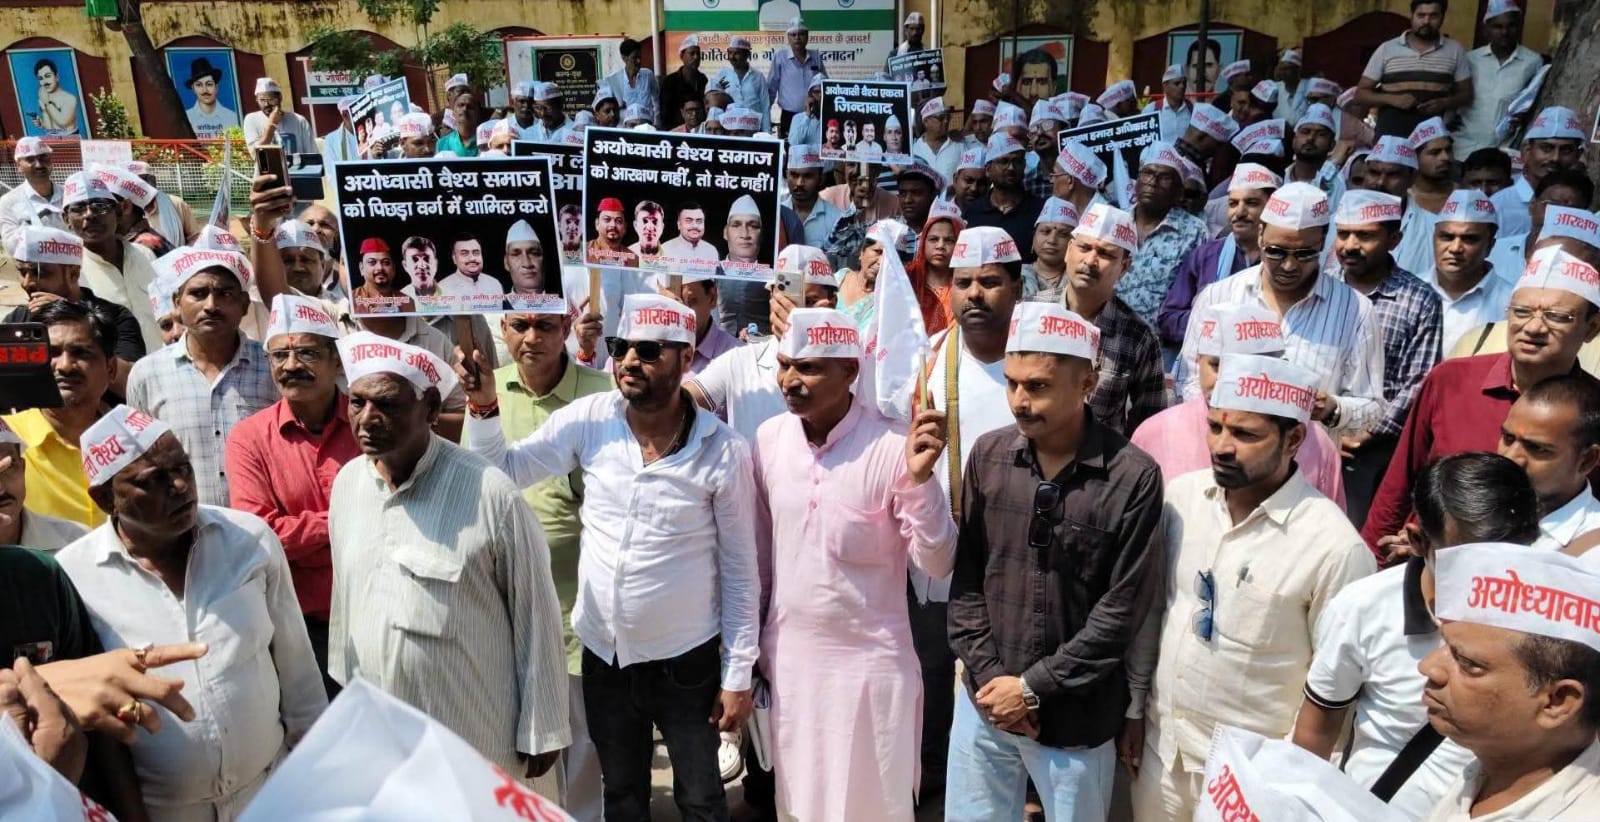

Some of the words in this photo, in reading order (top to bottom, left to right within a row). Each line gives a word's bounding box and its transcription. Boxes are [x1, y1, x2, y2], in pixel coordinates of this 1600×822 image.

[677, 140, 714, 162] वैश्य
[718, 149, 773, 166] समाज
[438, 166, 478, 188] वैश्य
[482, 170, 541, 188] समाज
[590, 163, 609, 180] को
[611, 167, 657, 182] आरक्षण
[696, 169, 712, 188] तो
[714, 170, 739, 187] वोट
[343, 198, 365, 218] को
[367, 197, 413, 221] पिछड़ा
[416, 195, 443, 216] वर्ग
[446, 195, 463, 215] में
[465, 194, 515, 215] शामिल
[519, 194, 549, 214] करो
[1039, 315, 1086, 338] आरक्षण
[350, 343, 402, 364] आरक्षण
